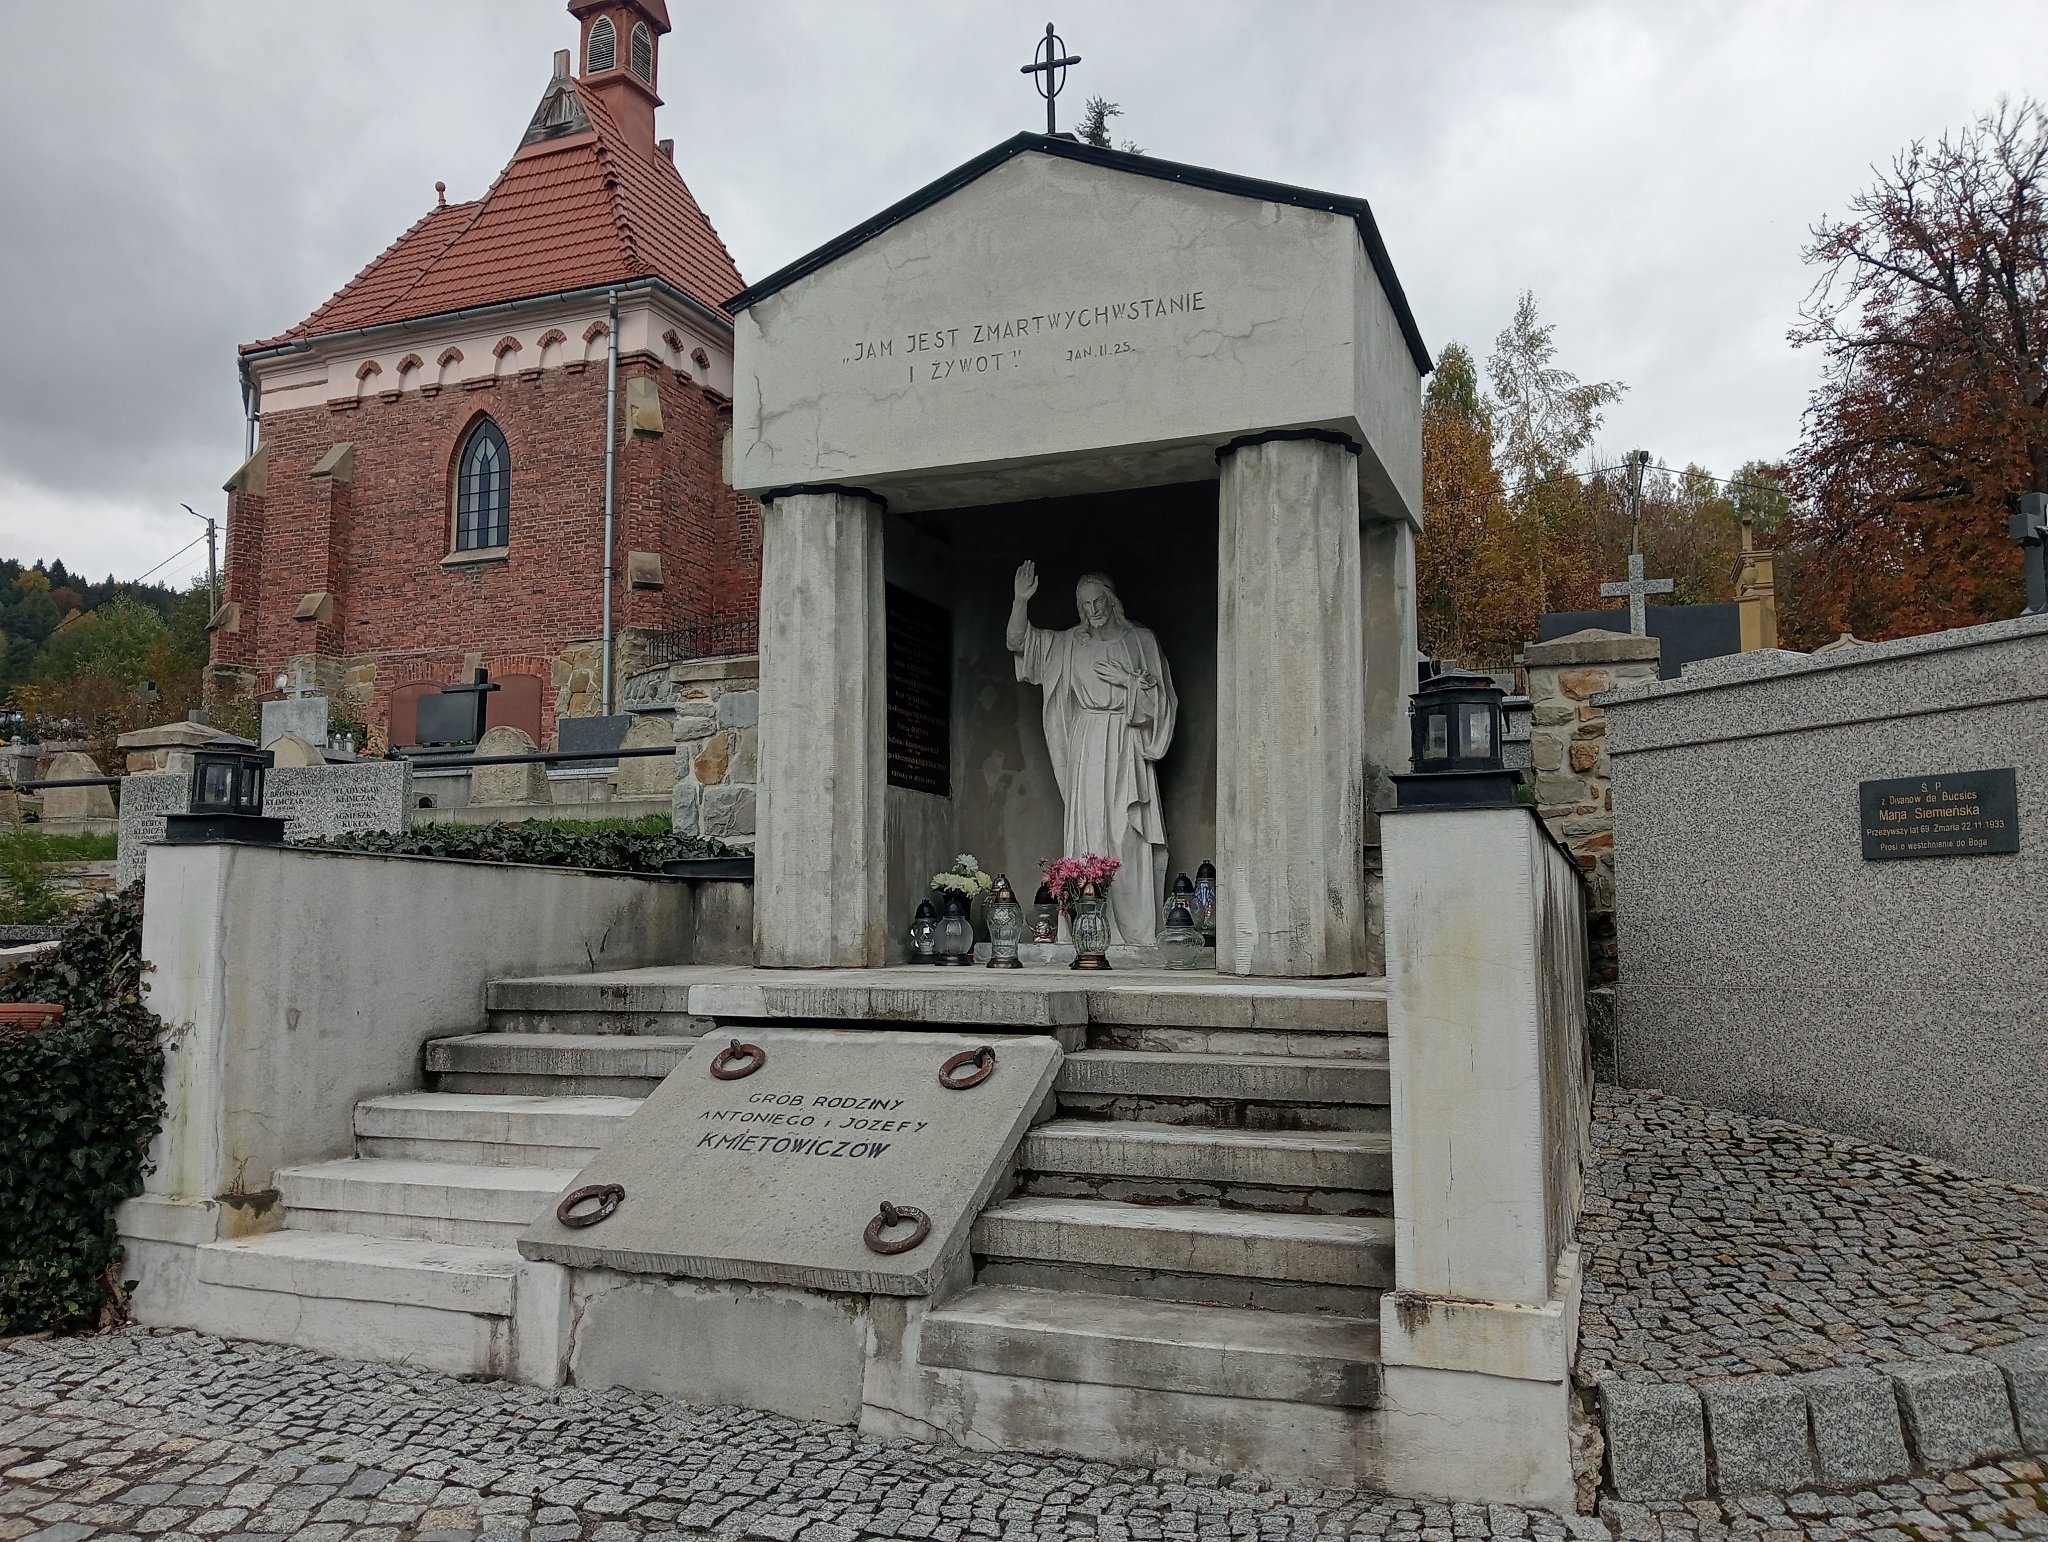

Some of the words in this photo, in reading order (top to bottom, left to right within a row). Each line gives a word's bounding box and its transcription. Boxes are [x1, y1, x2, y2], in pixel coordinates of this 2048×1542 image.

[906, 328, 959, 354] JEST
[972, 291, 1205, 344] ZMARTWYCHWSTANIE
[908, 365, 914, 384] I
[1926, 793, 1937, 803] de
[1914, 804, 1980, 820] Siemieńska
[133, 827, 166, 835] KLIMCZA
[1866, 827, 1909, 838] Przeżywszy
[1909, 825, 1919, 835] lat
[1920, 824, 1930, 834] 69
[1961, 821, 1971, 831] 22
[1974, 820, 1982, 830] 11
[1985, 819, 2005, 829] 1933
[1956, 839, 1966, 848] do
[1968, 837, 1988, 848] Boga
[812, 1095, 904, 1111] RODZINY
[698, 1110, 815, 1127] ANTONIEGO
